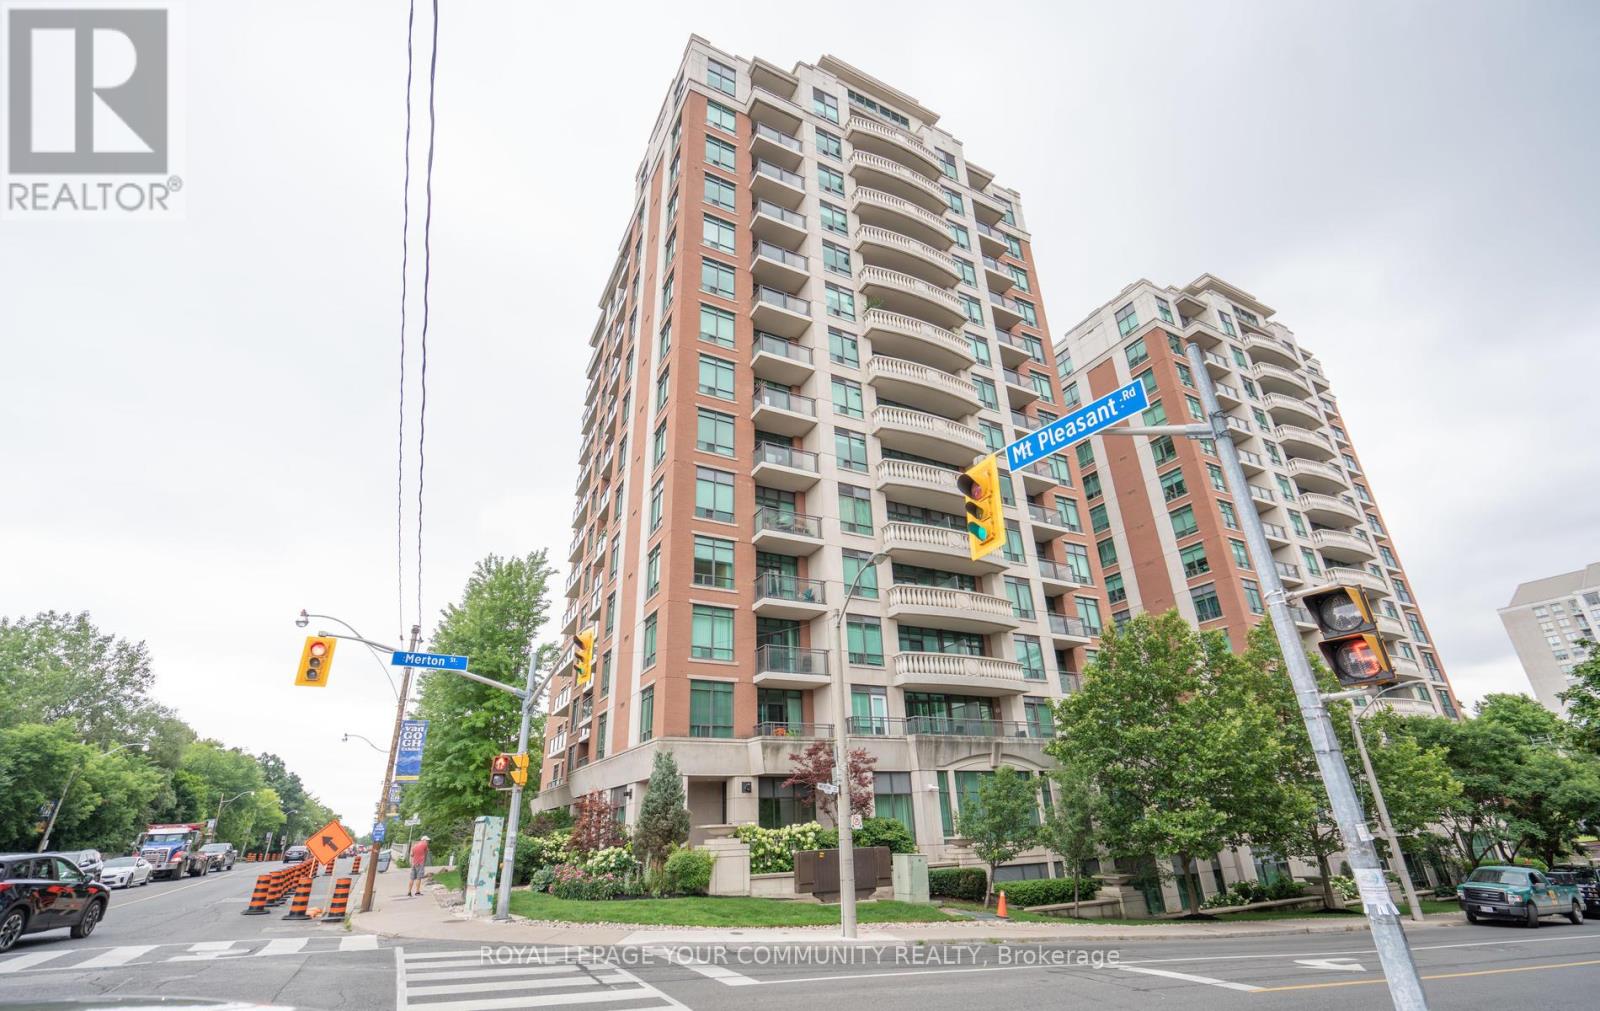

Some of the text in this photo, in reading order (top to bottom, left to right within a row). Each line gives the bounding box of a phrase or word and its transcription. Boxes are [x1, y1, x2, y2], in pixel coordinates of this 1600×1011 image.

[1012, 386, 1137, 464] Mt Pleasant Rd
[405, 653, 445, 666] Merton
[403, 731, 423, 740] GO
[402, 739, 422, 747] GH
